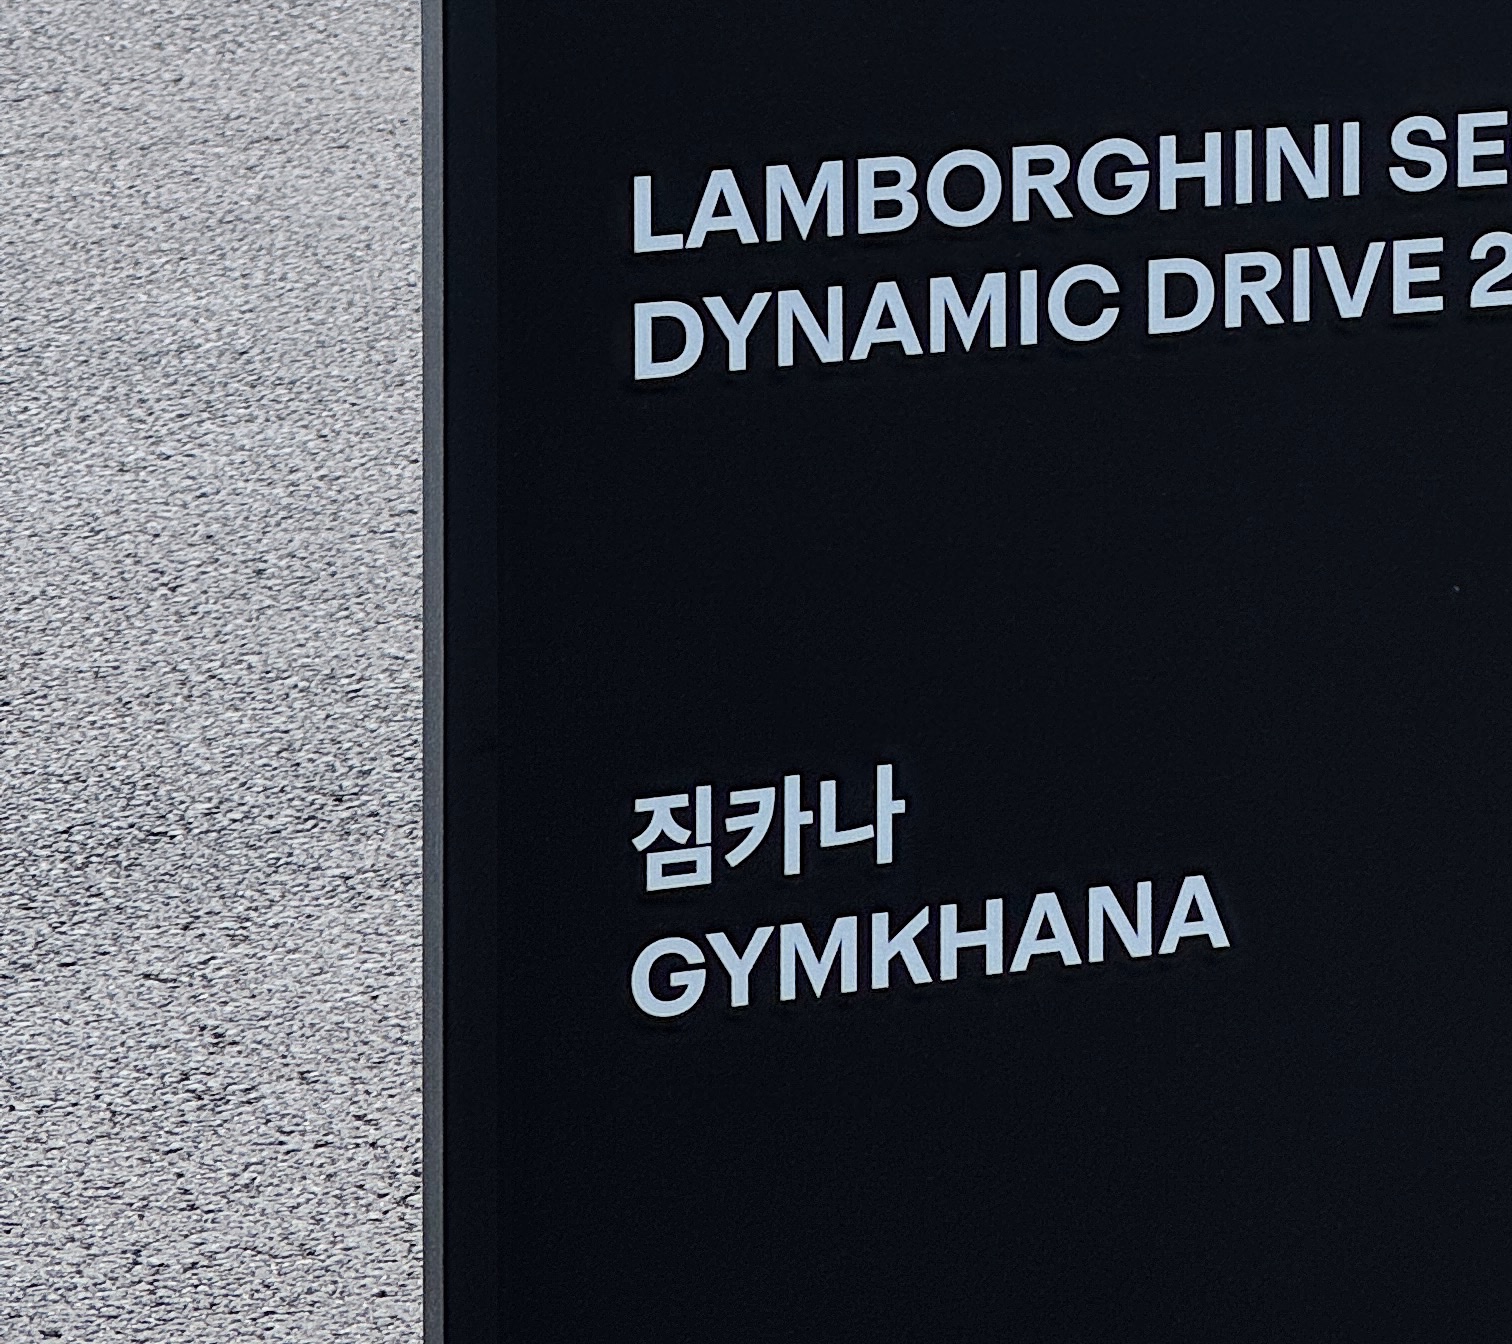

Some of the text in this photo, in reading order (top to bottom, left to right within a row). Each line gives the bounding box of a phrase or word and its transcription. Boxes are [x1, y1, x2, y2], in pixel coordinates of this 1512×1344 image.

[633, 121, 1361, 254] LAMBORGHINI
[634, 263, 1121, 381] DYNAMIC
[1147, 231, 1444, 335] DRIVE
[631, 763, 906, 892] 짐카나
[630, 874, 1231, 1018] GYMKHANA
